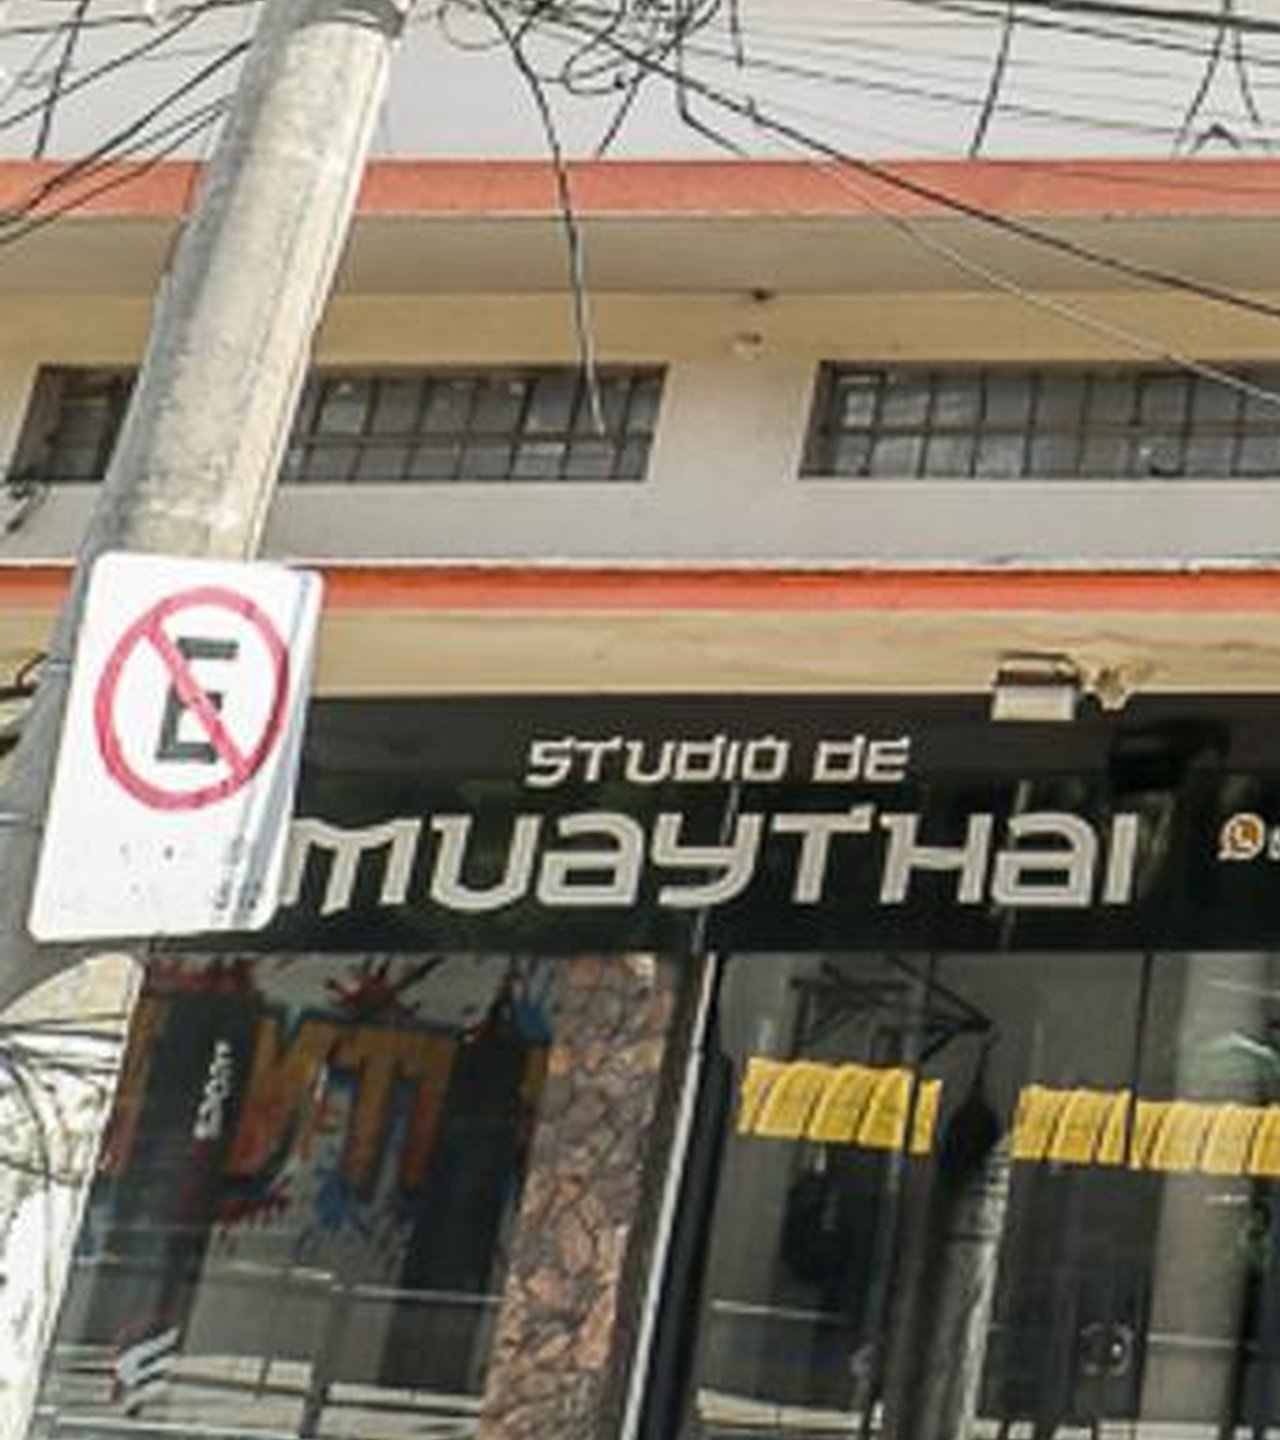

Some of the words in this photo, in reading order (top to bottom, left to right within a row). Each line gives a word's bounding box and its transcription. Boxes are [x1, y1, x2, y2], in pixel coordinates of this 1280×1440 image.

[154, 635, 239, 765] E
[525, 733, 787, 787] STUDIO
[811, 734, 911, 785] DE
